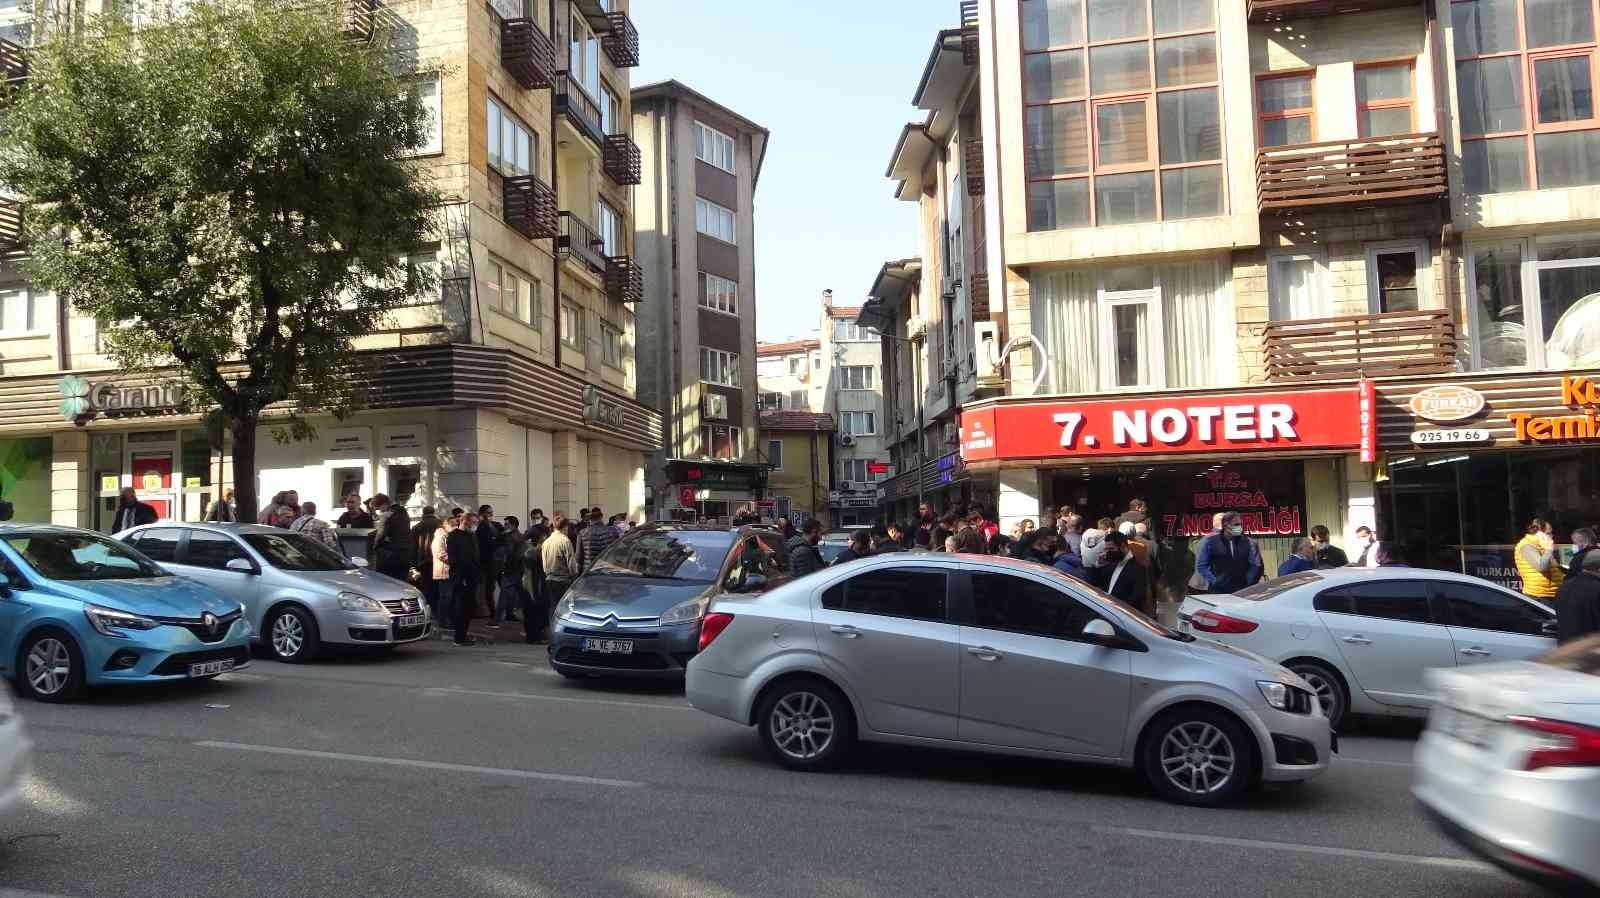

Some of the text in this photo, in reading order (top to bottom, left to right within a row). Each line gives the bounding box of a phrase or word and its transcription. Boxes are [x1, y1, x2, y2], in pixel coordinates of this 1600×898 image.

[1053, 402, 1298, 448] 7. NOTER
[1360, 398, 1369, 462] NOTER
[1419, 431, 1480, 442] 225 19 66
[1507, 411, 1600, 442] Temi
[1193, 489, 1269, 509] BURSA
